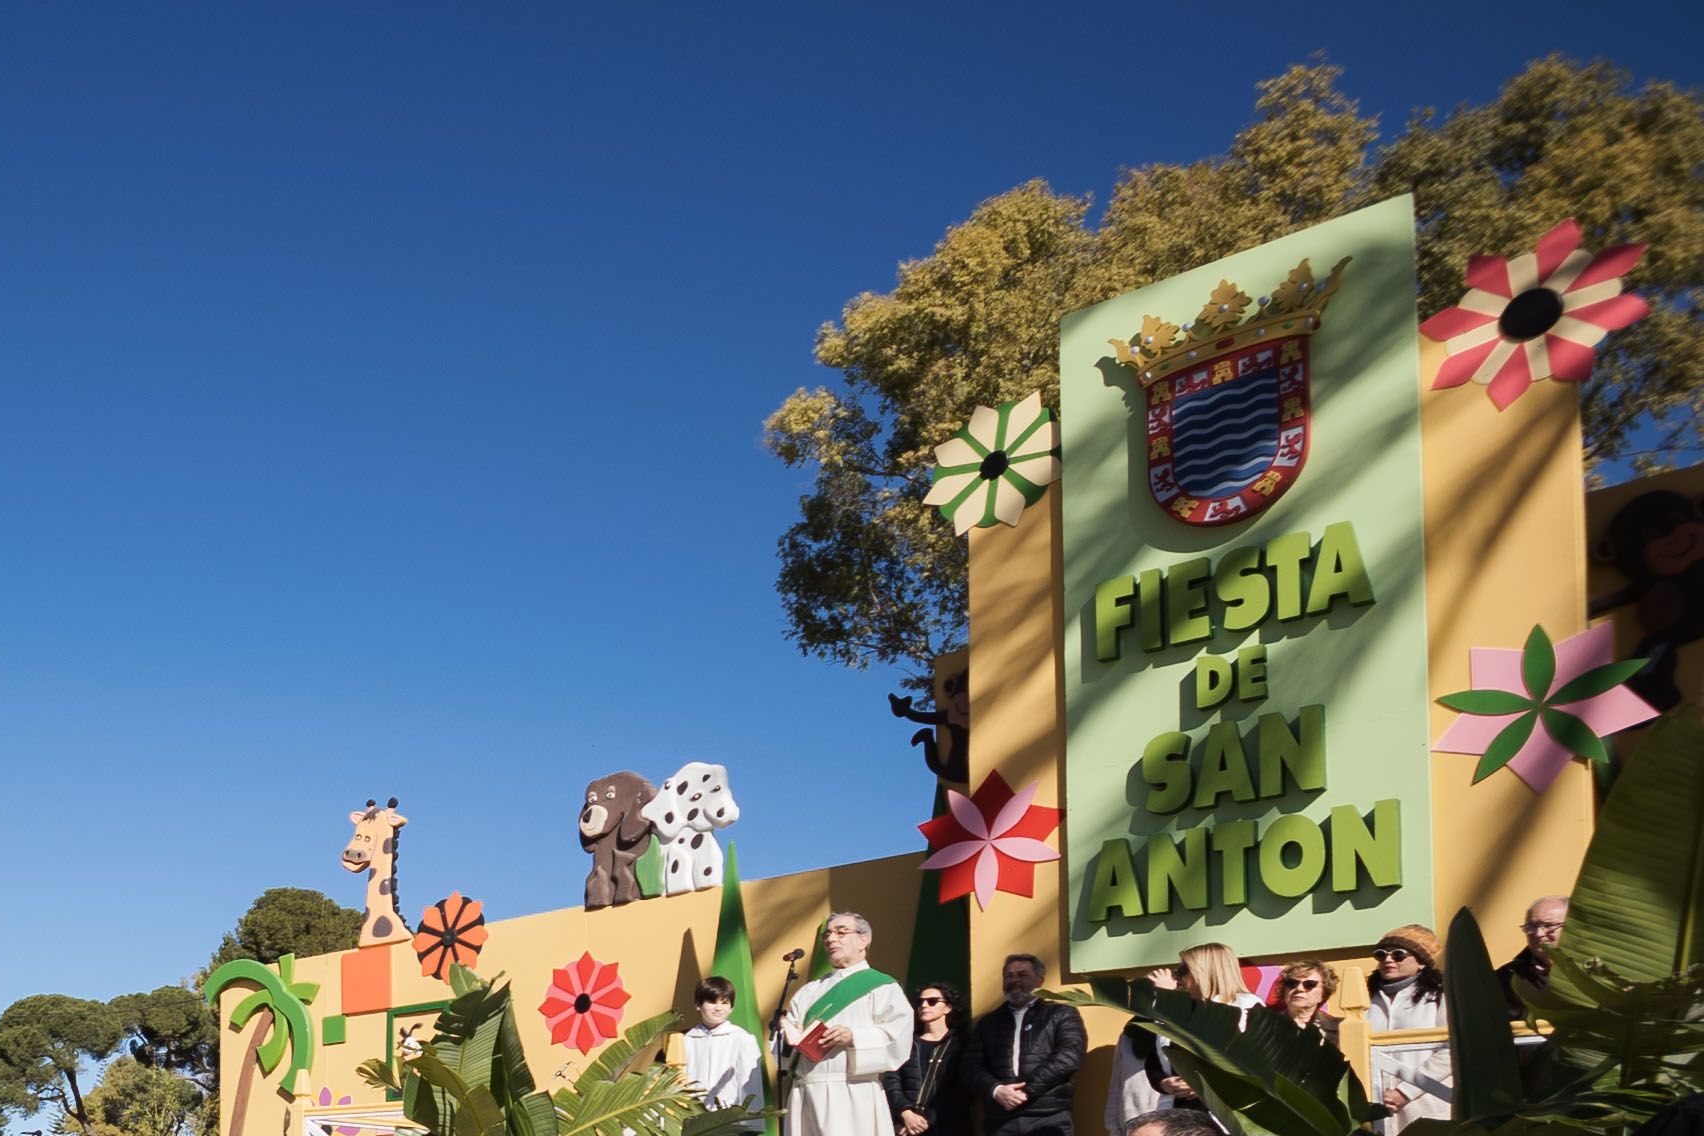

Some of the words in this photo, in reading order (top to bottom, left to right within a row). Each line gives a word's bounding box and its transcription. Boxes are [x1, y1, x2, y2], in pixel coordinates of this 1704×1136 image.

[1095, 520, 1376, 662] FIESTA
[1196, 644, 1269, 710] DE
[1141, 703, 1327, 815] SAN
[1087, 798, 1402, 924] ANTON
